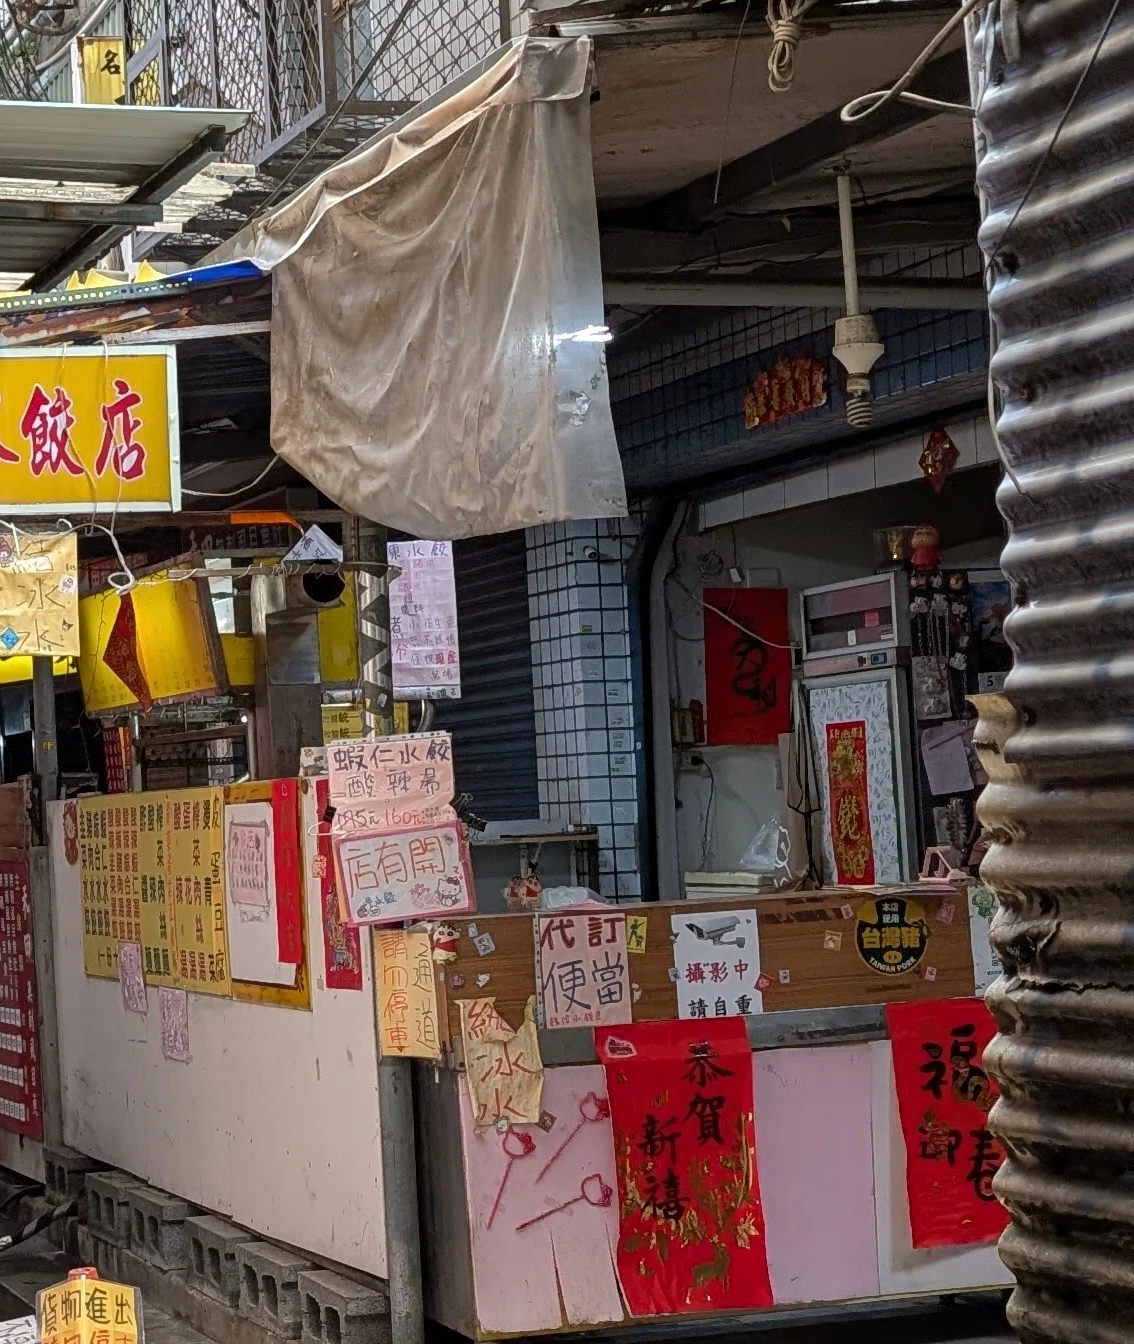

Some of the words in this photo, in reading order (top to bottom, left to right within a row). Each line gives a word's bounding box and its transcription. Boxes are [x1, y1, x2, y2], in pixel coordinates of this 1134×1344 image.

[334, 739, 451, 772] 蝦仁水餃
[345, 835, 447, 899] 店有開
[542, 916, 626, 950] 代訂
[862, 926, 920, 949] 台灣豬
[544, 951, 625, 1014] 便當
[685, 958, 750, 984] 攝影中
[868, 956, 896, 973] TAIWAN
[896, 957, 917, 971] PORK
[380, 931, 409, 1053] 請勿停車
[688, 994, 753, 1018] 請自重
[679, 1039, 734, 1146] 恭賀
[636, 1113, 691, 1223] 新禧
[43, 1286, 133, 1335] 貨物進出
